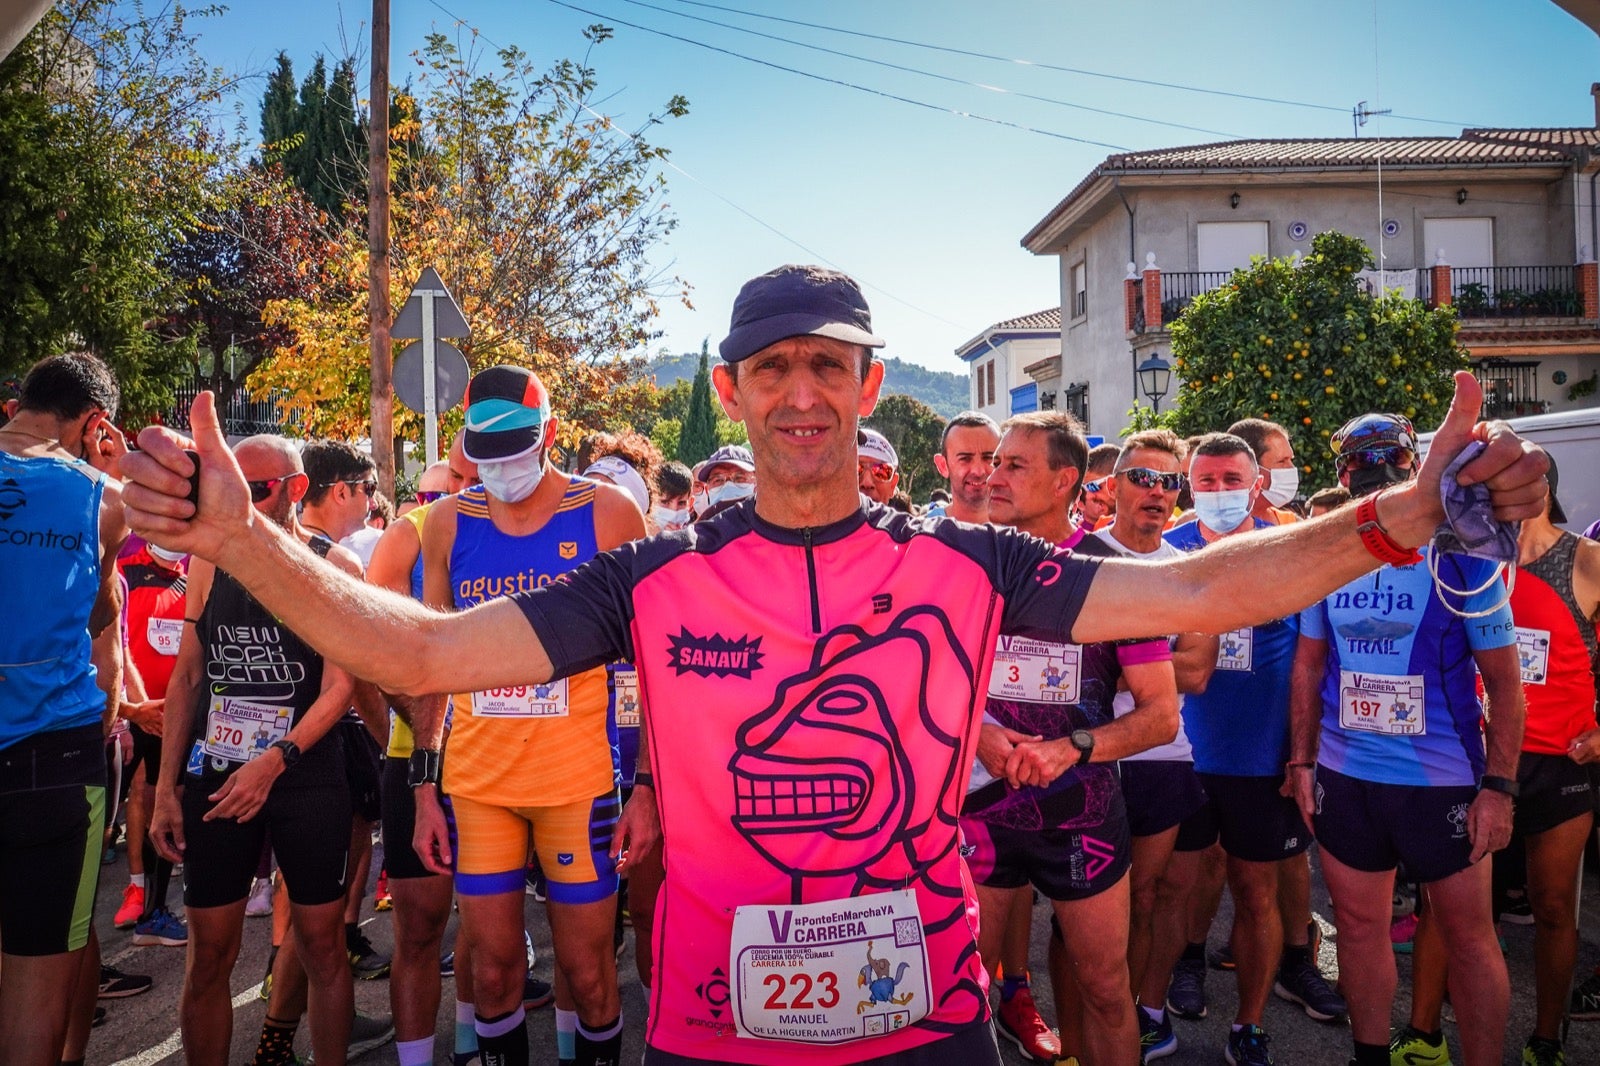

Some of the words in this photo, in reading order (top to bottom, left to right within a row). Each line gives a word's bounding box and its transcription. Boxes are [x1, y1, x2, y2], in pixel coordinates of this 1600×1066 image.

[1333, 585, 1415, 616] nerja
[158, 635, 171, 646] 95
[218, 624, 280, 644] NEW
[1000, 636, 1013, 651] V
[1012, 646, 1050, 655] CARRERA
[1347, 637, 1400, 656] TRAIL
[210, 644, 286, 665] YORK
[227, 665, 292, 682] CITY
[1008, 665, 1020, 683] 3
[1353, 673, 1362, 688] V
[1362, 683, 1396, 692] CARRERA
[223, 698, 232, 713] V
[229, 707, 263, 720] CARRERA
[1350, 699, 1381, 717] 197
[214, 725, 243, 746] 370
[767, 910, 793, 944] V
[794, 905, 894, 926] #PonteEnMarchaYA
[794, 921, 867, 943] CARRERA
[804, 951, 834, 960] CURABLE
[751, 960, 786, 968] CARRERA
[762, 971, 840, 1010] 223
[779, 1014, 828, 1024] MANUEL
[753, 1026, 765, 1034] DE
[766, 1027, 777, 1035] LA
[779, 1028, 819, 1038] HIGUERA
[820, 1026, 856, 1038] MARTIN
